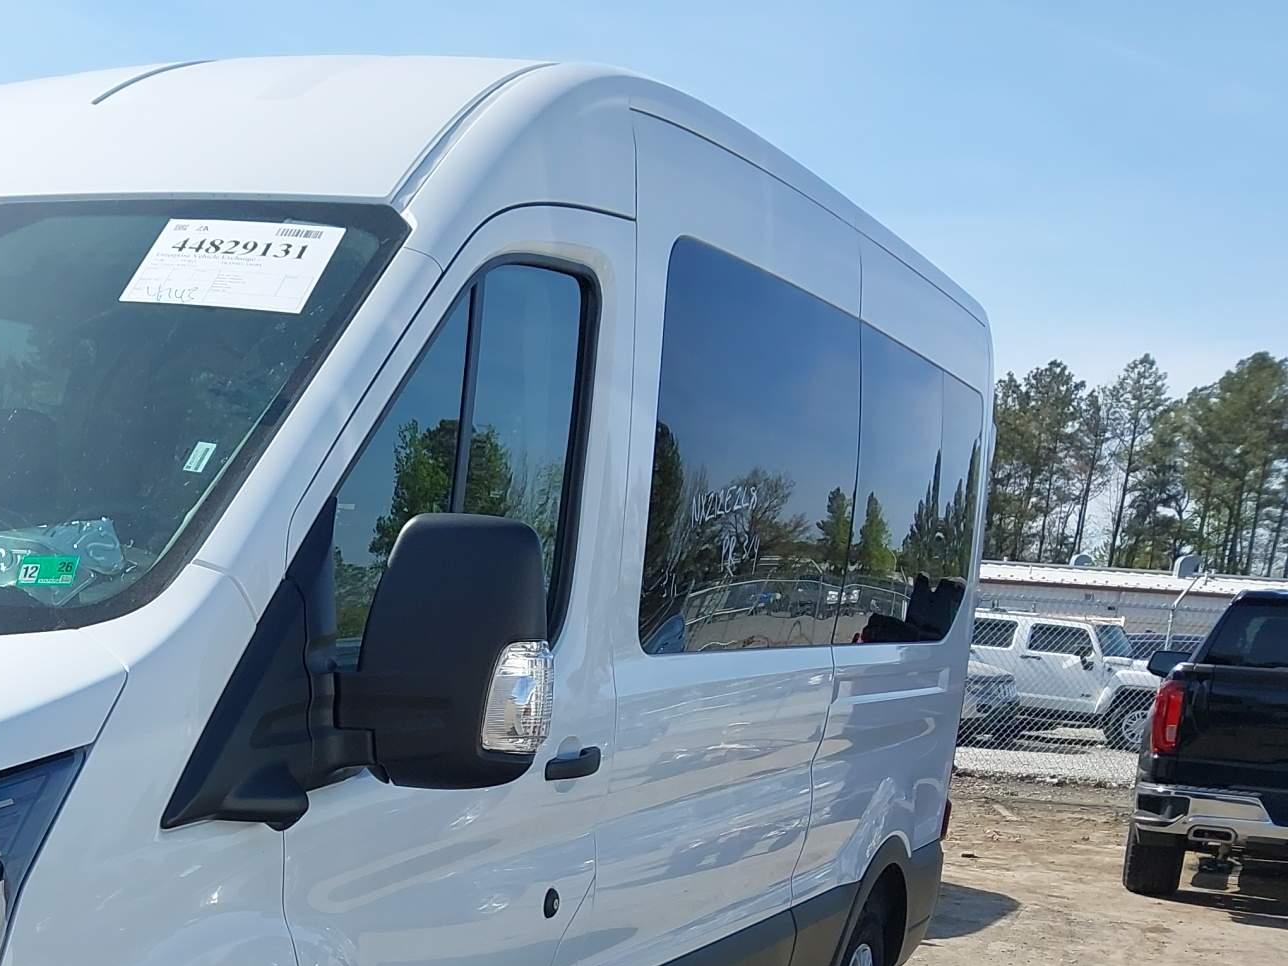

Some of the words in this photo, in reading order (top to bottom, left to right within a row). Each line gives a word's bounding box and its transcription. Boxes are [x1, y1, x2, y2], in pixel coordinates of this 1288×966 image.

[172, 238, 309, 259] 44829131
[22, 565, 39, 579] 12
[57, 561, 73, 573] 26
